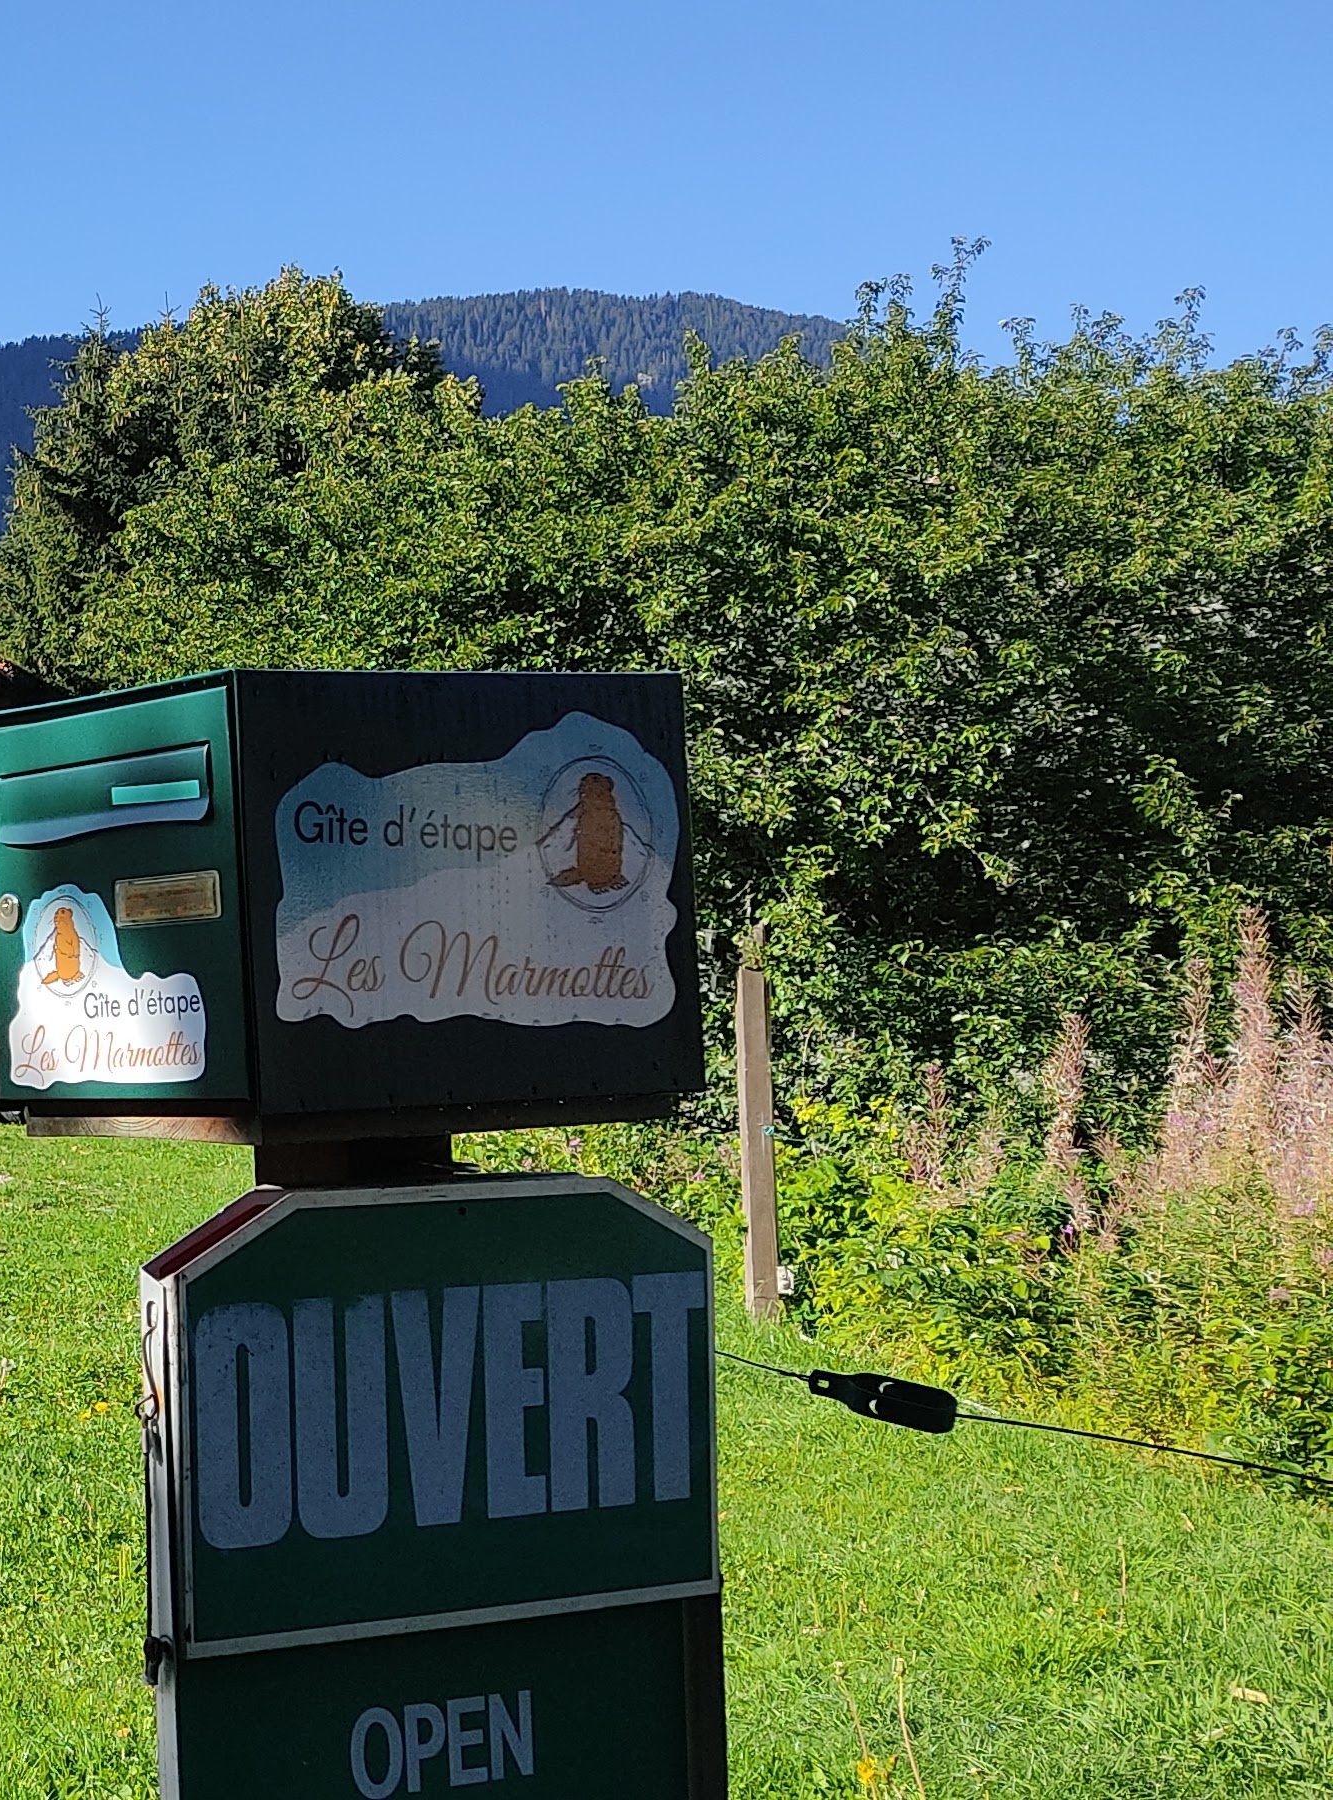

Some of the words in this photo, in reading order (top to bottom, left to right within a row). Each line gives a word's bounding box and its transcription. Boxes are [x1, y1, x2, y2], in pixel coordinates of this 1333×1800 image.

[294, 800, 369, 846] Gîte
[382, 804, 518, 862] d'étape
[83, 991, 121, 1019] Gîte
[127, 987, 201, 1021] d'étape
[292, 913, 384, 1018] Les
[399, 919, 654, 1005] Marmottes
[14, 1024, 59, 1087] Les
[64, 1024, 202, 1074] Marmottes
[194, 1271, 705, 1550] OUVERT
[349, 1689, 535, 1800] OPEN
